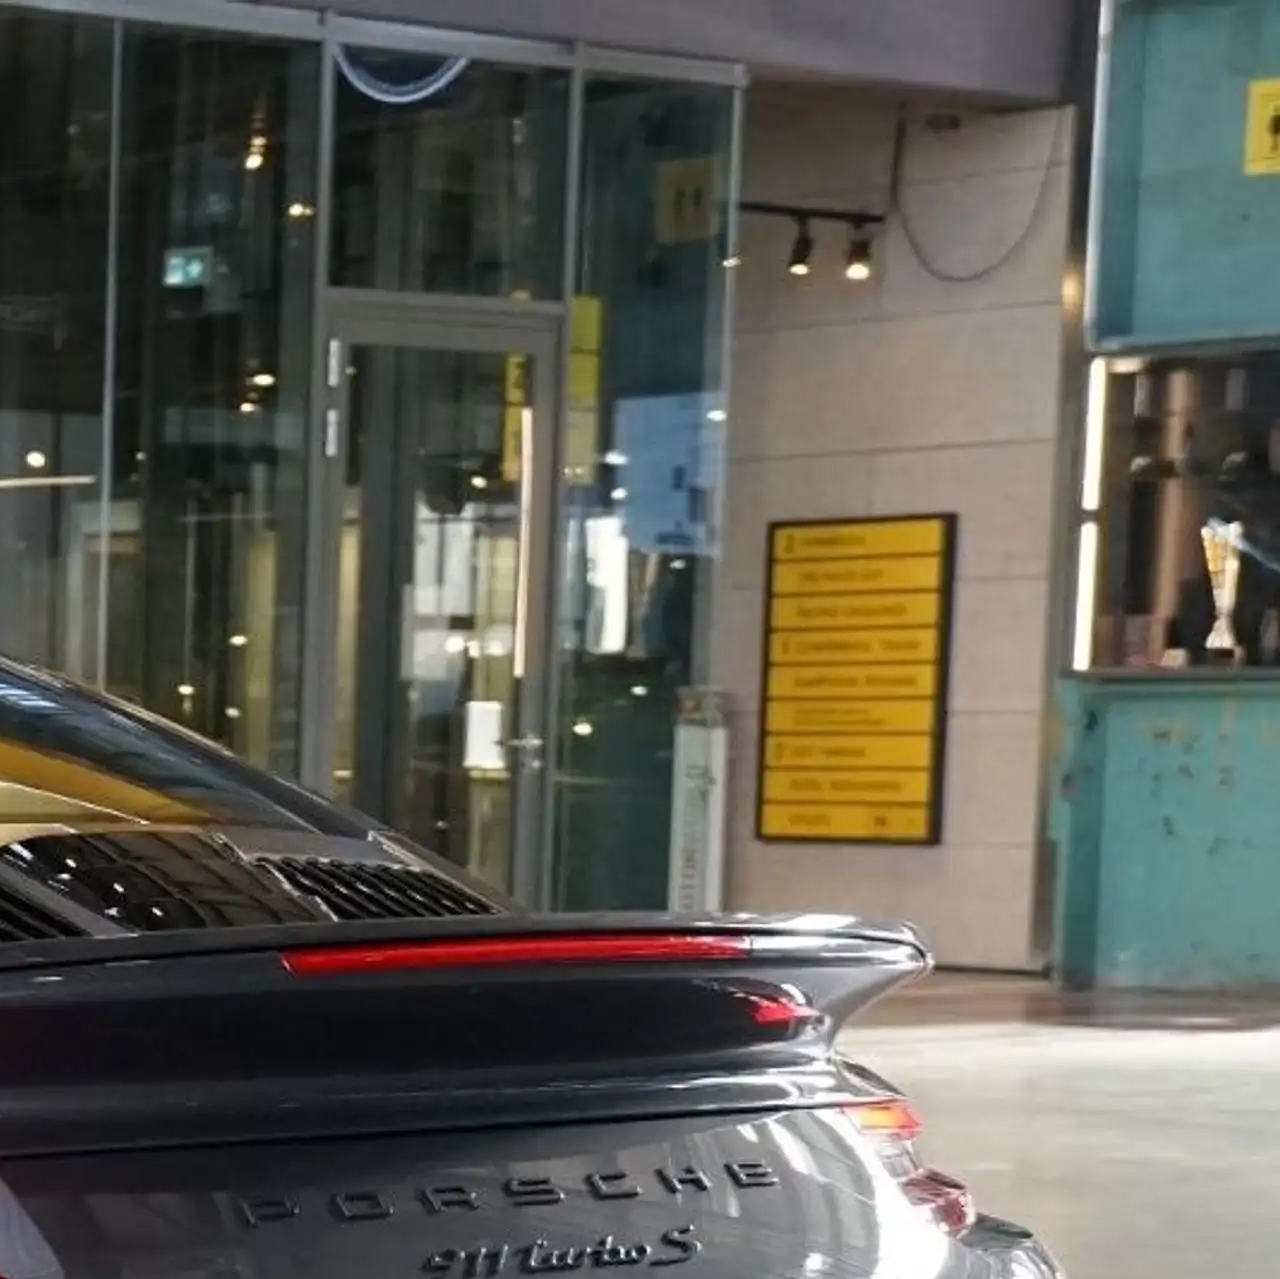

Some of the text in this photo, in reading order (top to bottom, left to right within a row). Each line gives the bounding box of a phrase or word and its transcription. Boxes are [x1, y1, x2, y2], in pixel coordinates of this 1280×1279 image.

[242, 1158, 779, 1228] PORSCHE
[514, 1233, 650, 1277] turbo
[647, 1223, 704, 1268] S
